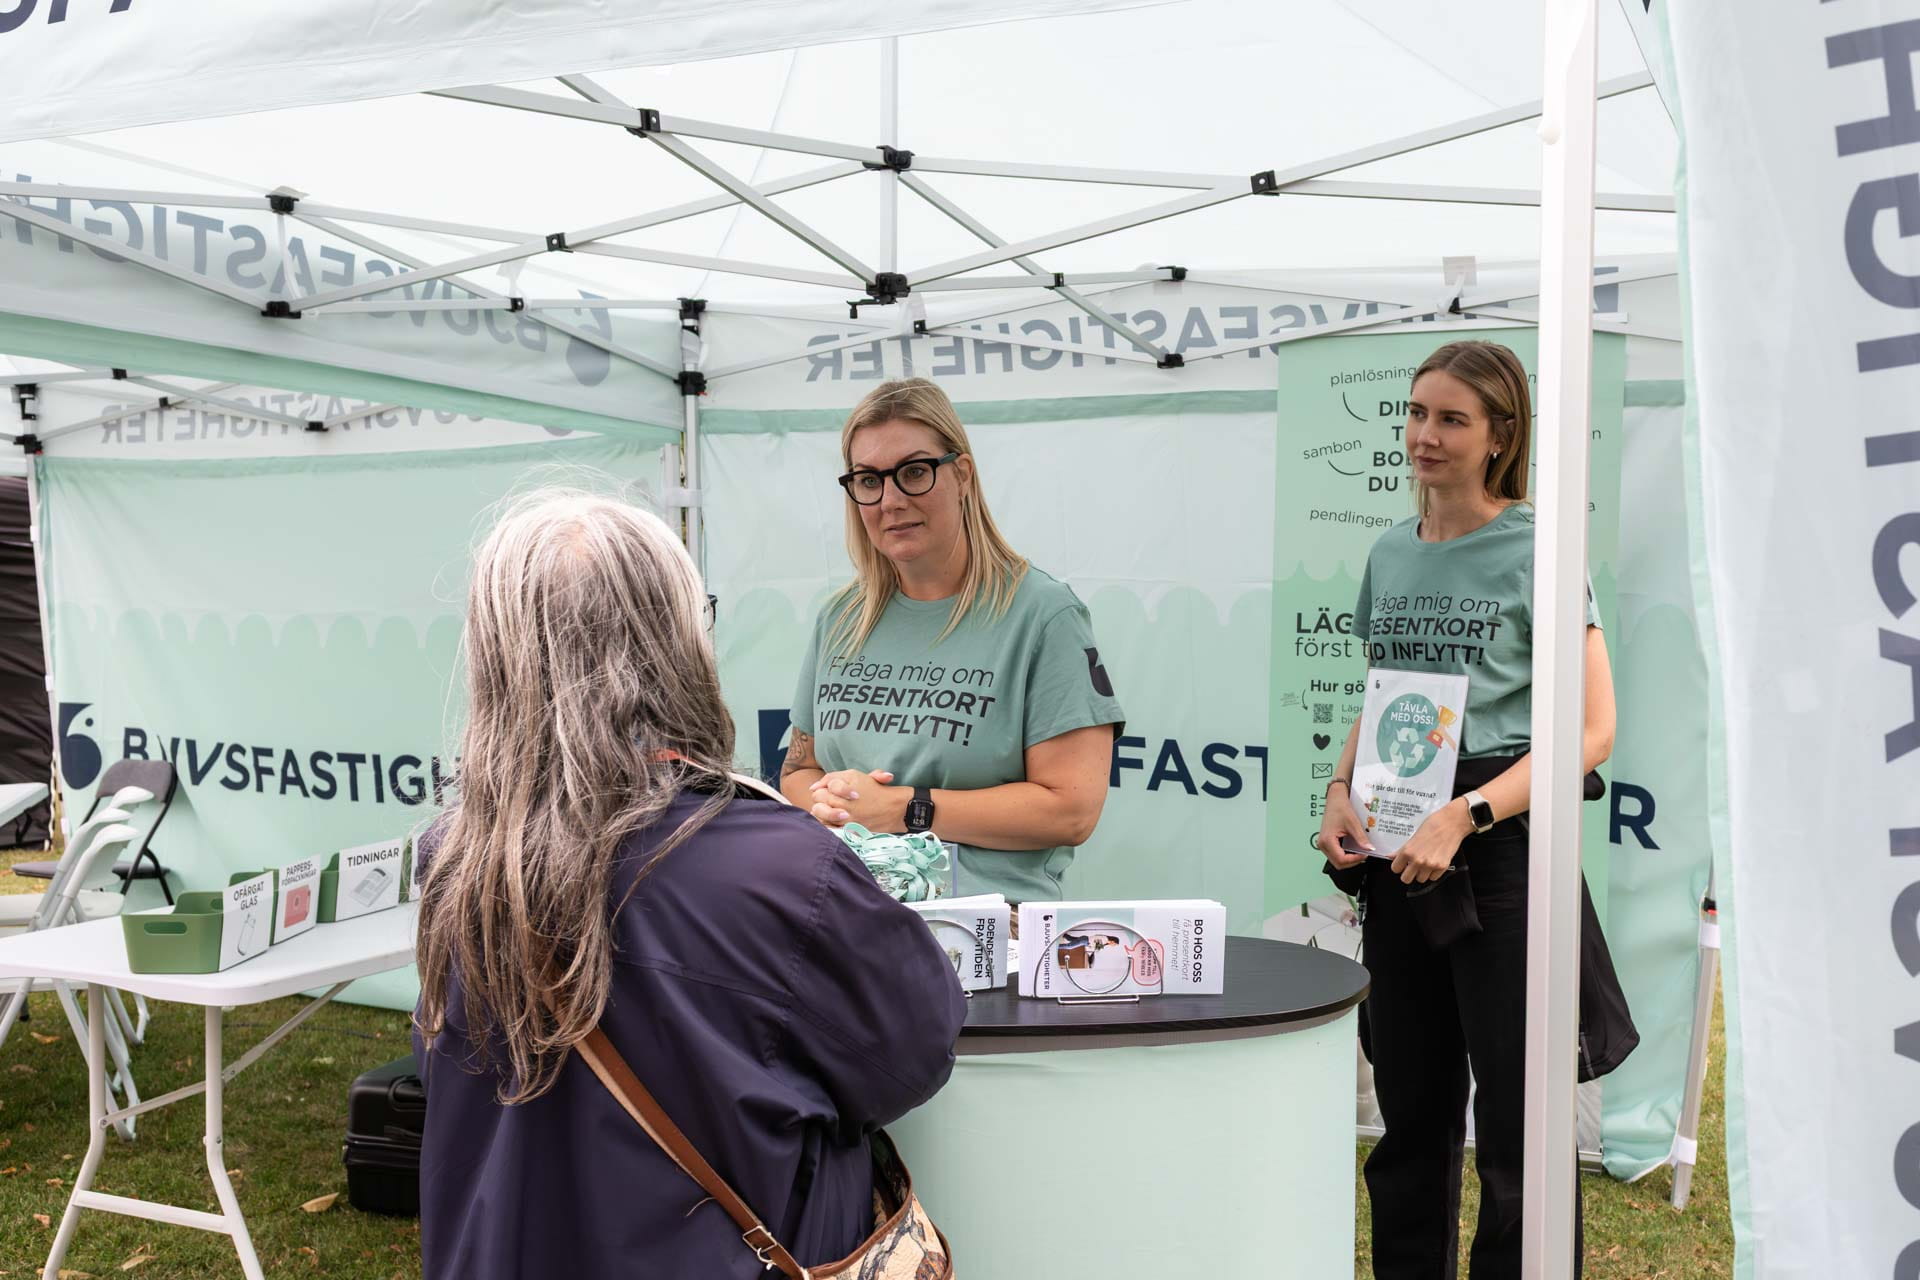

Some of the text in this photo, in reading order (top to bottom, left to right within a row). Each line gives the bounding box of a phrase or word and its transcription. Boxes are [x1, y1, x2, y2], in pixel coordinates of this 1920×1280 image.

[1330, 366, 1417, 387] planlösning
[1303, 439, 1362, 460] sambon
[1368, 476, 1399, 492] DU
[1310, 509, 1393, 528] pendlingen
[1414, 591, 1453, 615] mig
[1460, 598, 1500, 615] om
[1295, 637, 1353, 658] först
[1369, 641, 1485, 666] ID INFLYTT!
[828, 655, 995, 688] Fråga mig om
[1310, 679, 1339, 693] Hur
[817, 683, 996, 718] PRESENTKORT
[1399, 701, 1429, 715] TÄVLA
[819, 709, 974, 747] VID INFLYTT!
[1390, 711, 1435, 726] MED OSS!
[346, 847, 400, 867] TIDNINGAR
[240, 896, 258, 911] GLAS
[1181, 930, 1190, 981] presentkort
[1192, 919, 1203, 983] BO HOS OSS
